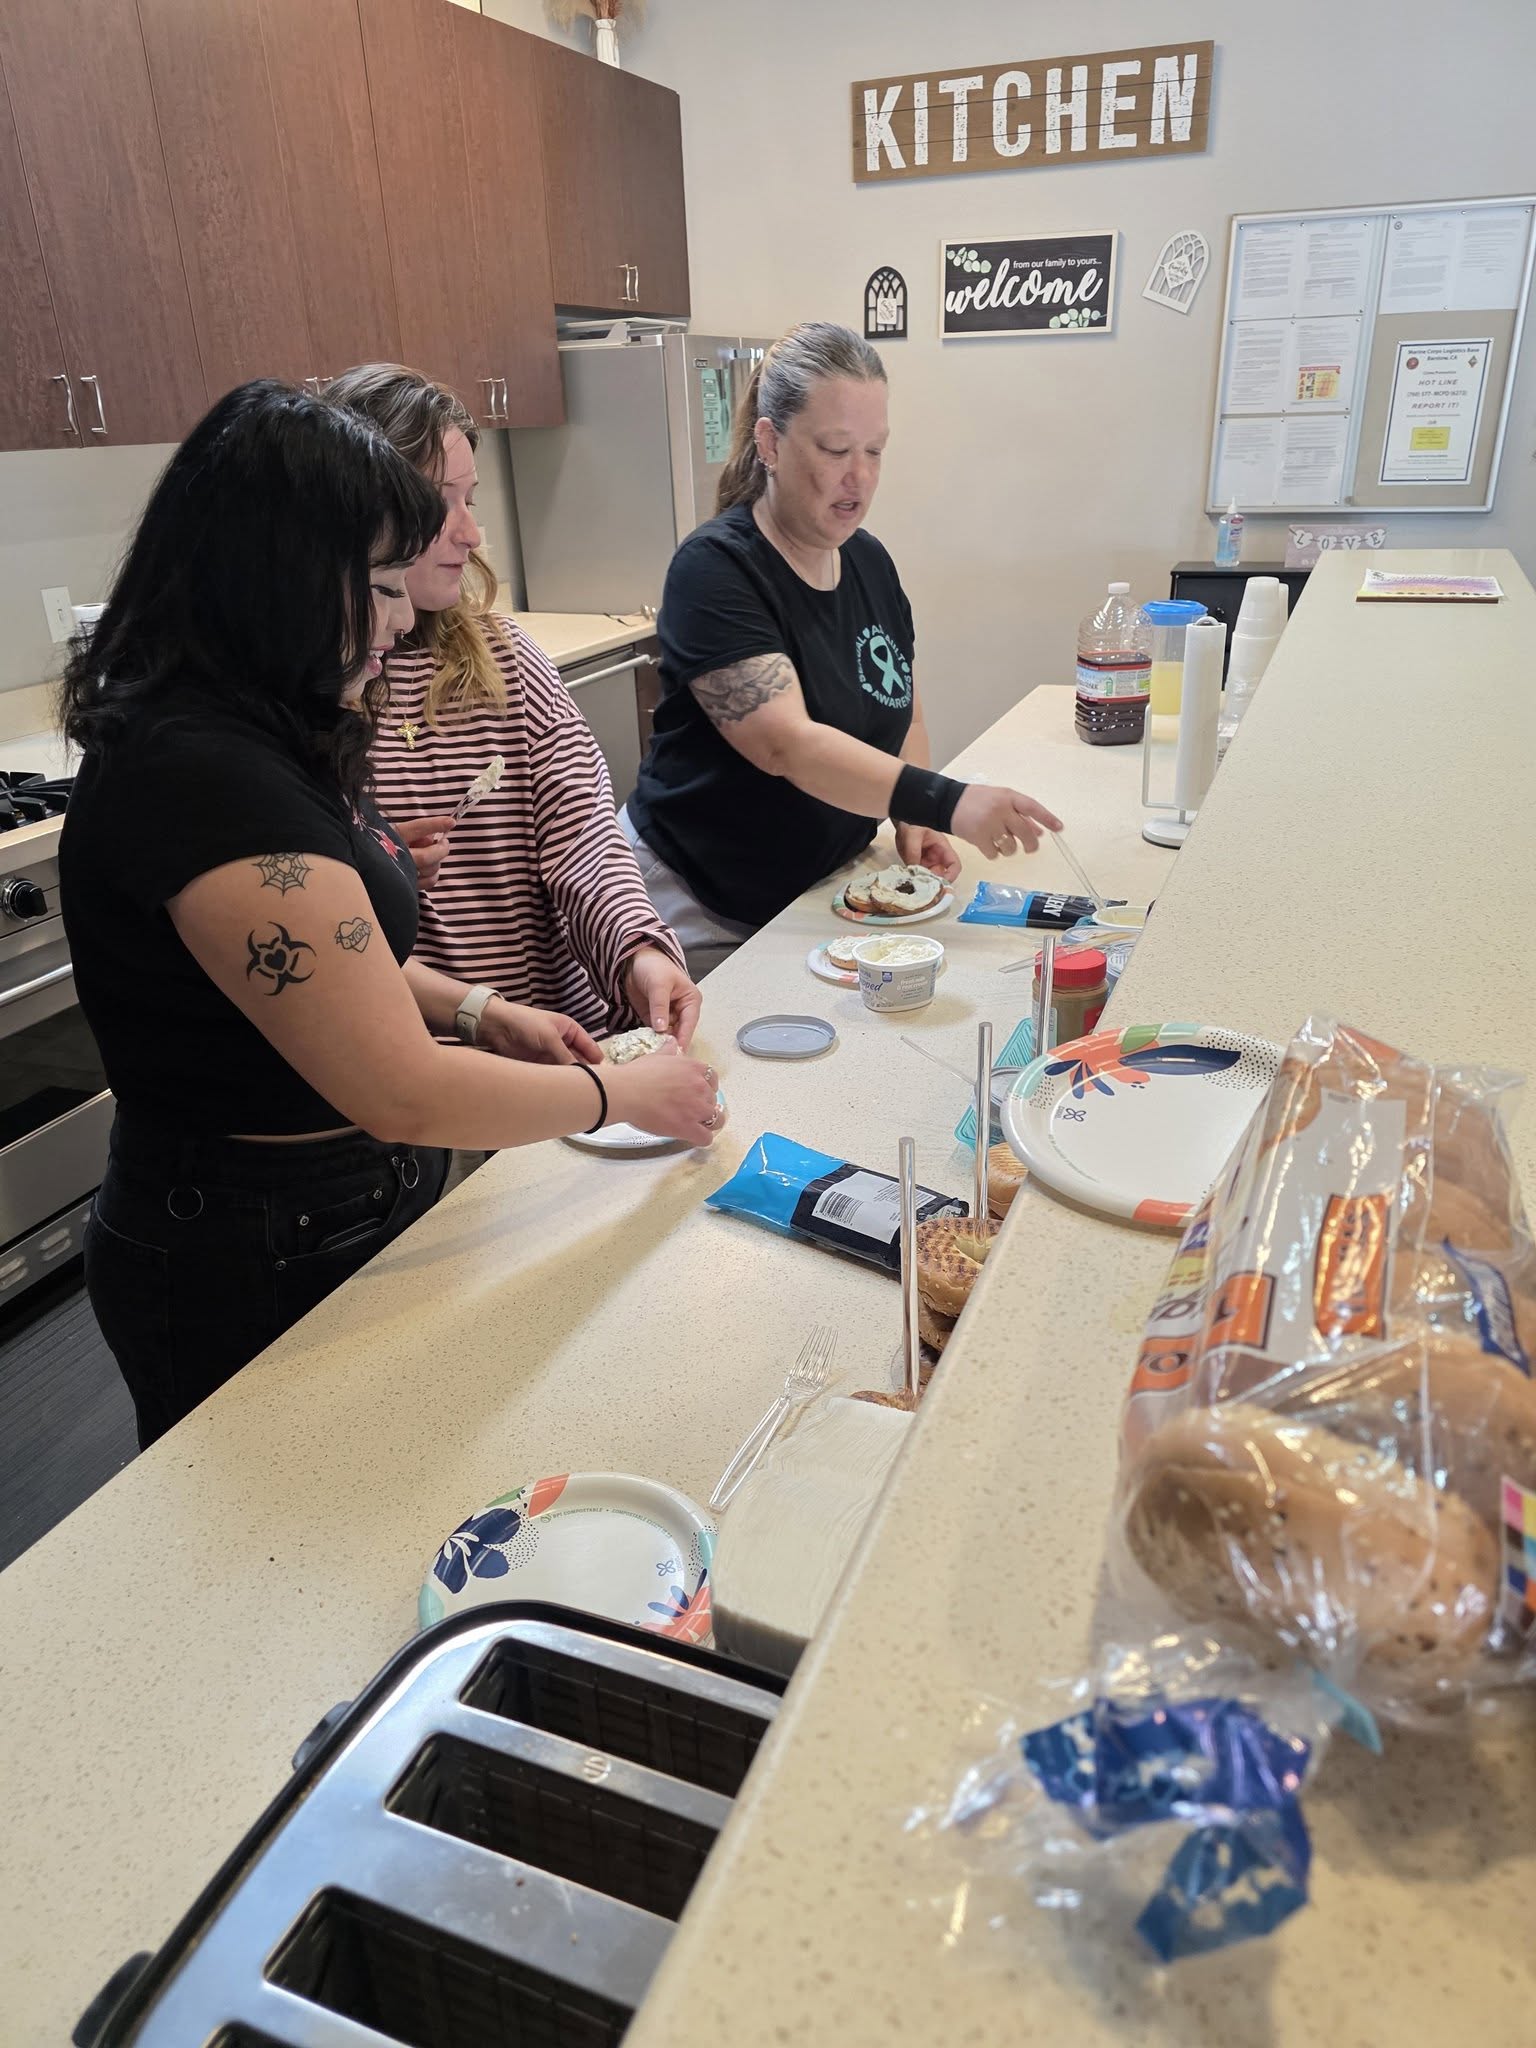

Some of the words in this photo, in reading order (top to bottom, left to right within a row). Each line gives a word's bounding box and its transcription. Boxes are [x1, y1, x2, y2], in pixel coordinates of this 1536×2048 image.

[864, 54, 1198, 171] KITCHEN
[1013, 260, 1030, 268] from
[1045, 258, 1066, 268] family
[1067, 258, 1076, 266] to
[945, 258, 1103, 314] welcome
[350, 924, 367, 944] MOM
